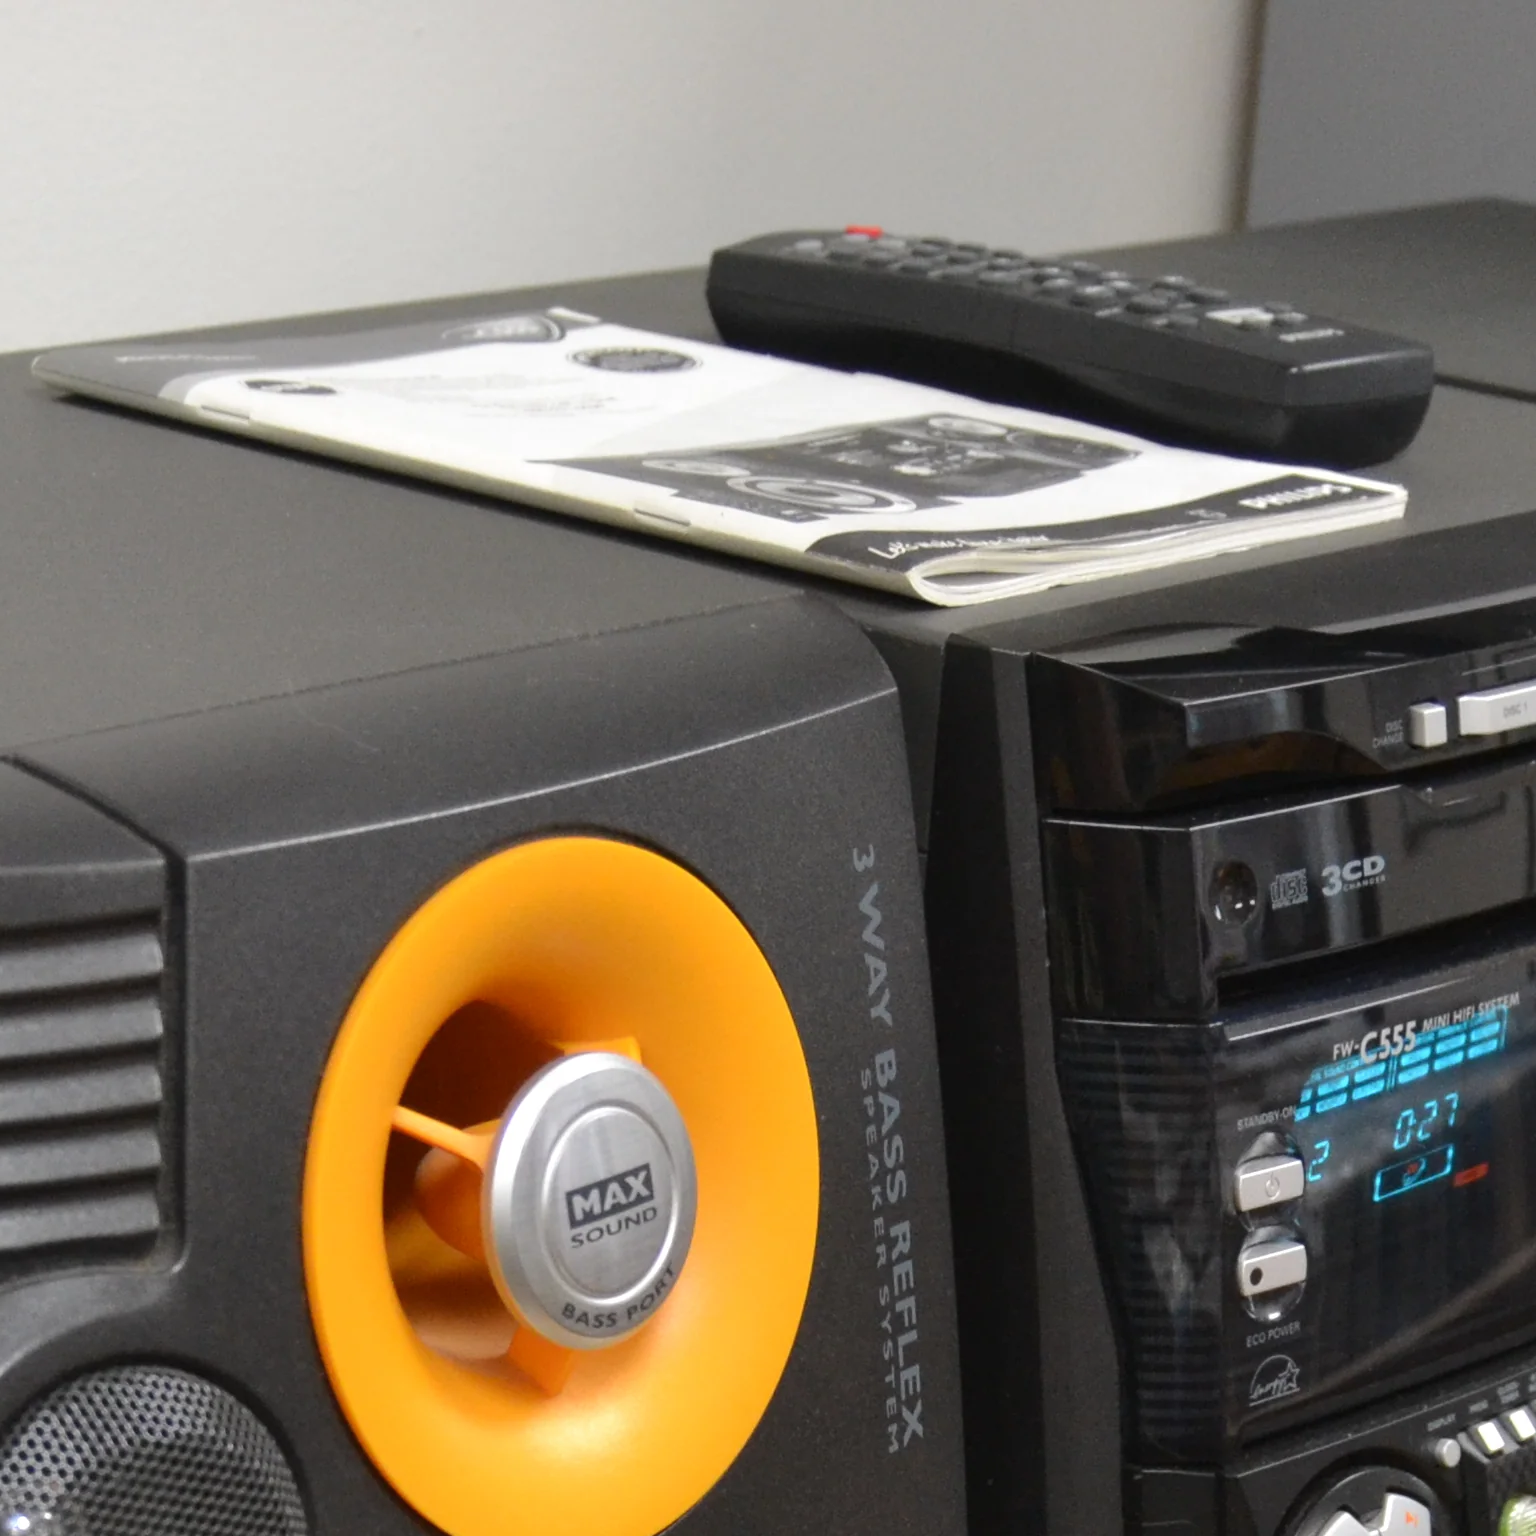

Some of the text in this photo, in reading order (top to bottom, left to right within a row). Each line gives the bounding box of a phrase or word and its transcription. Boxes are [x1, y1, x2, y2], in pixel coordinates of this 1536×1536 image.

[1422, 1012, 1450, 1033] MINI
[1453, 1004, 1476, 1025] HIFI
[1478, 991, 1521, 1016] SYSTEM
[853, 843, 924, 1449] 3 WAY BASS REFLEX
[1307, 1139, 1331, 1183] 2
[570, 1169, 652, 1222] MAX
[570, 1207, 658, 1249] SOUND
[861, 1067, 899, 1455] SPEAKER SYSTEM
[561, 1262, 675, 1329] BASS PORT
[1246, 1320, 1301, 1348] ECO POWER
